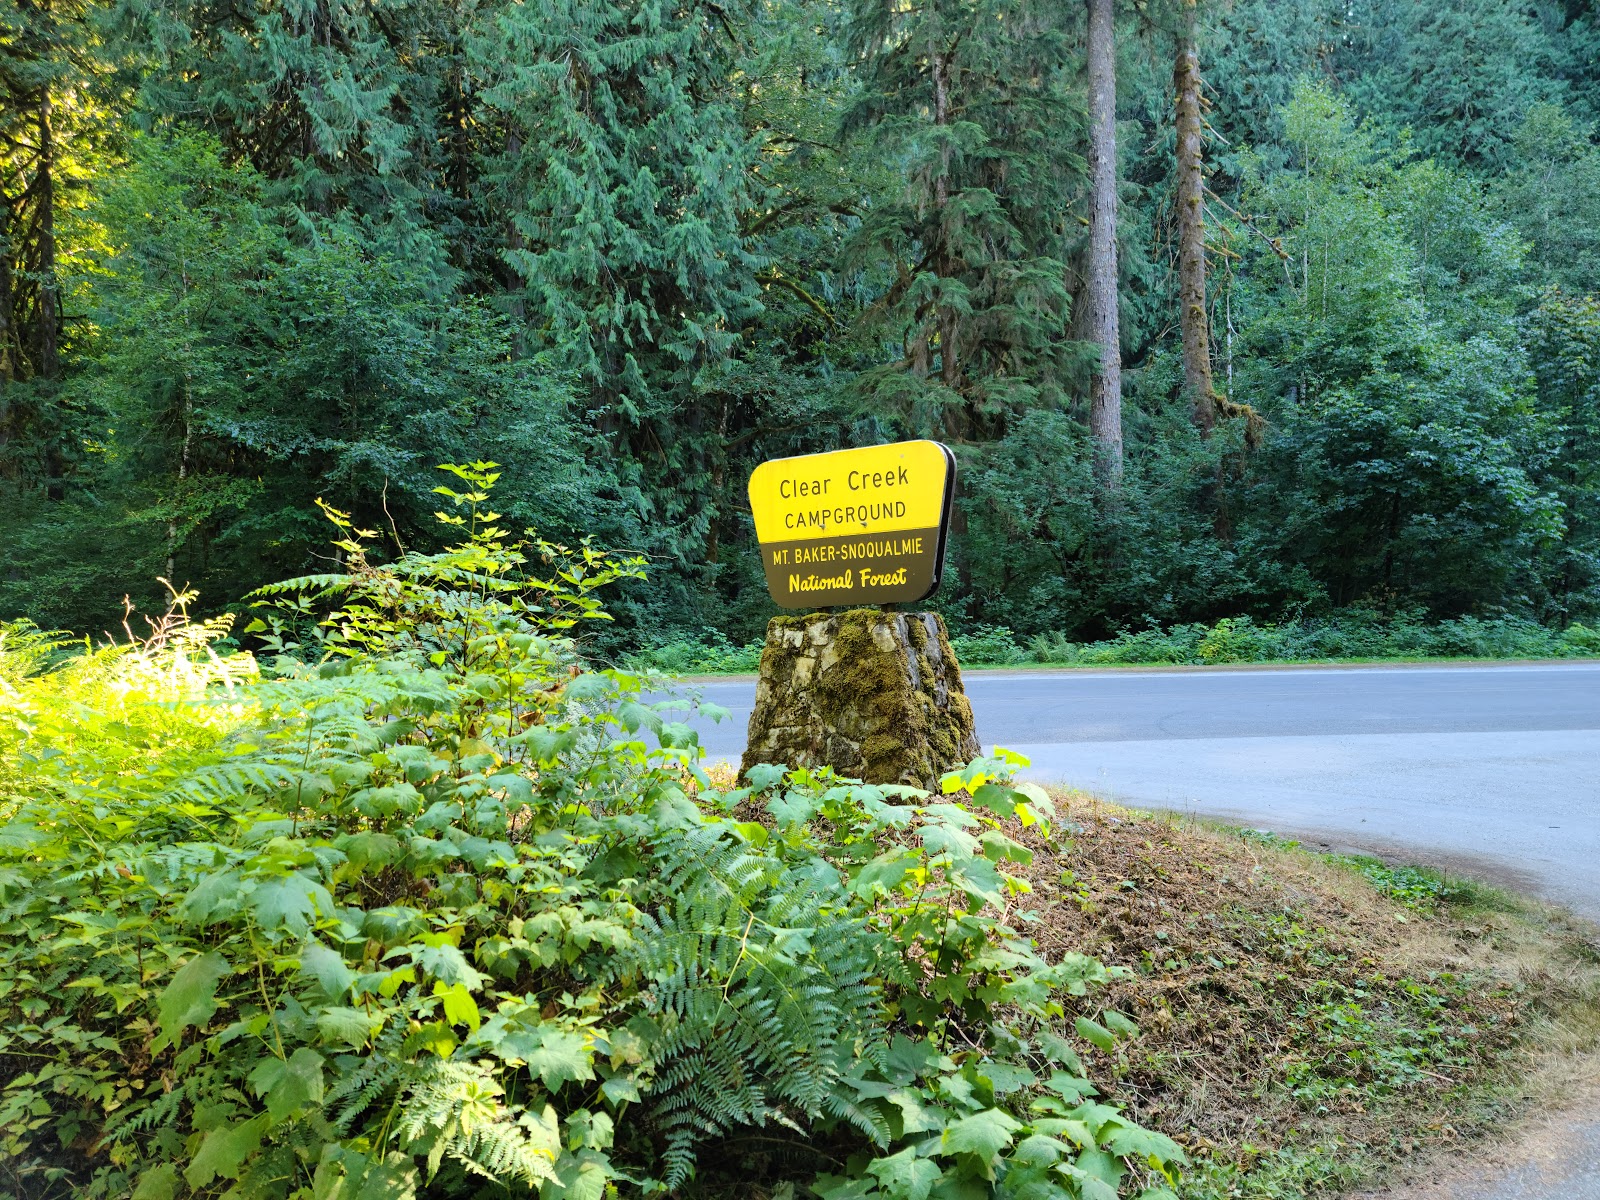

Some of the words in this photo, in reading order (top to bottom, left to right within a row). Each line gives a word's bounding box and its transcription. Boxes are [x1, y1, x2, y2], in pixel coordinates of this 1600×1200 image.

[780, 478, 831, 499] Clear
[848, 465, 909, 491] Creek
[785, 501, 906, 529] CAMPGROUND
[773, 550, 791, 566] MT.
[795, 537, 923, 564] BAKER-SNOQUALMIE
[789, 568, 854, 593] National
[859, 567, 907, 587] Forest
